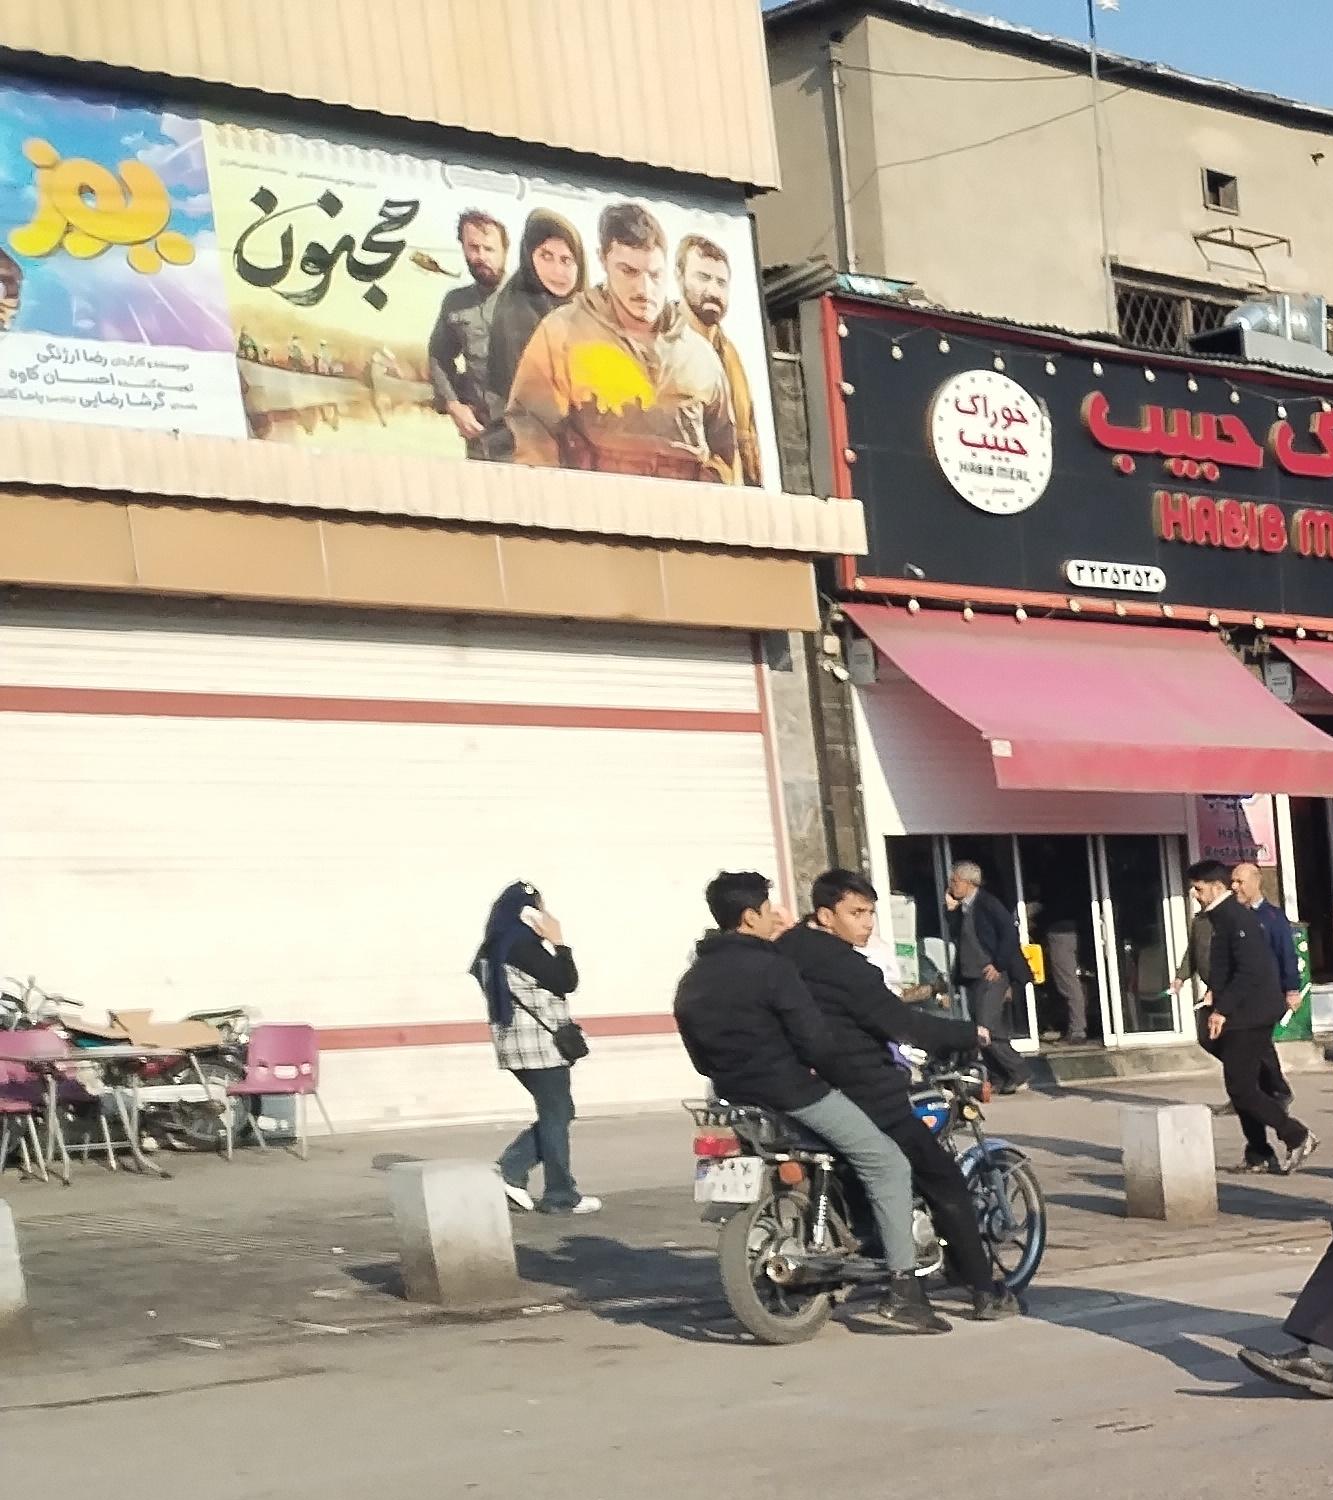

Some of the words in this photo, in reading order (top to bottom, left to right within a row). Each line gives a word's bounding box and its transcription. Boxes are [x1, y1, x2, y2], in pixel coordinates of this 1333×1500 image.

[232, 186, 420, 312] مجنون
[955, 394, 1029, 430] خوراک
[1080, 389, 1265, 482] حبیب
[959, 430, 1029, 462] حبیب
[1155, 489, 1288, 553] HABIB
